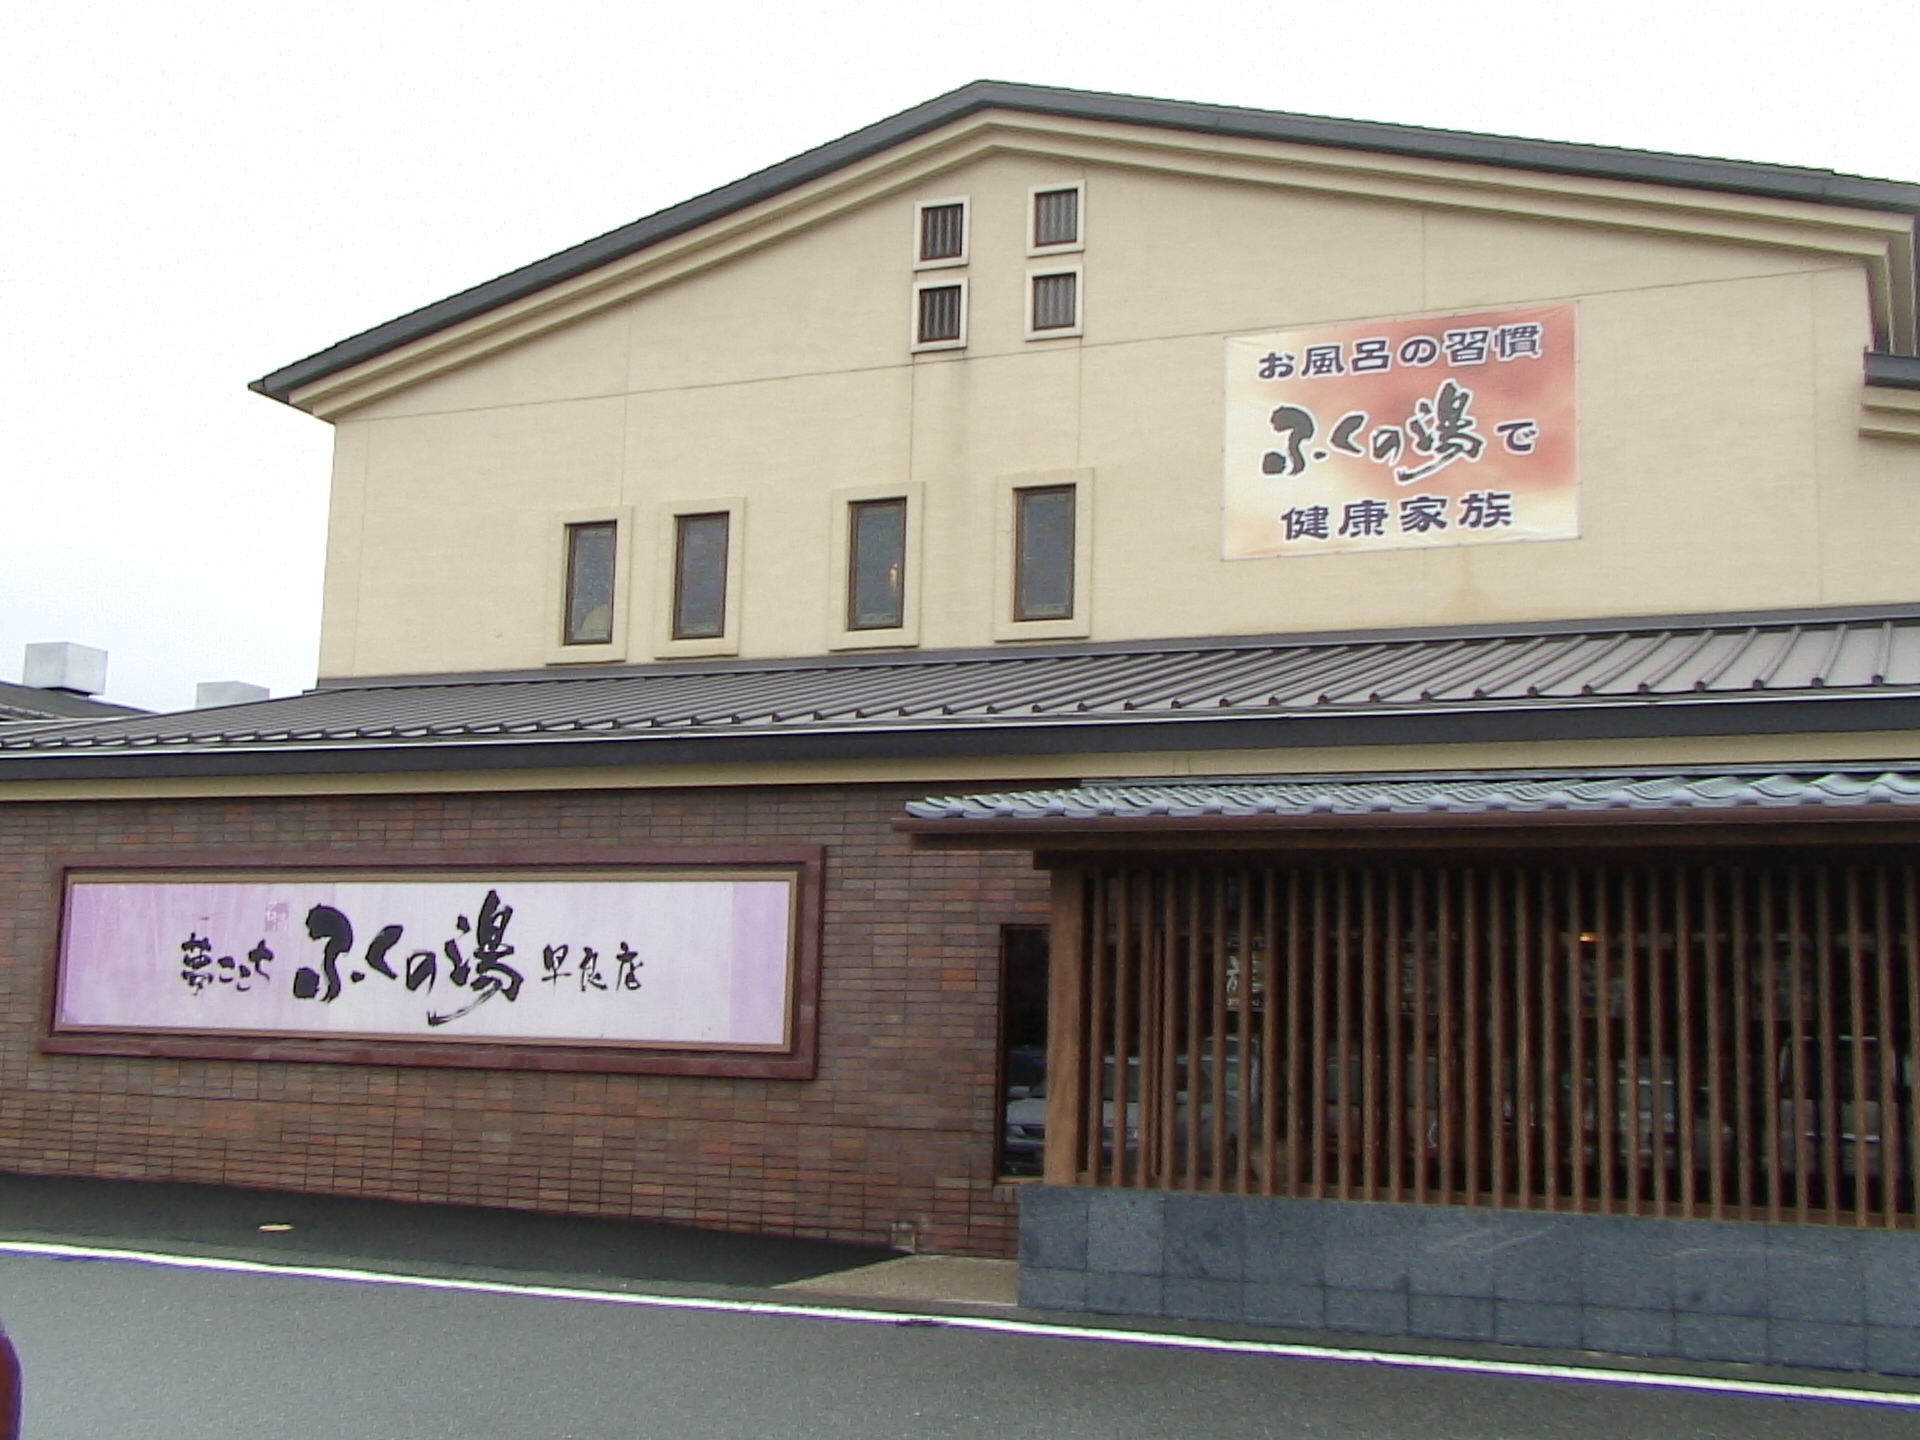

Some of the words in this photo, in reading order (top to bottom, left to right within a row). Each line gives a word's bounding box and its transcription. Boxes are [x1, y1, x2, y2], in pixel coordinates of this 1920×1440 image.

[1258, 324, 1541, 379] お風呂の習慣
[1280, 492, 1512, 541] 健康家族
[294, 889, 524, 1027] ふくの湯
[541, 941, 644, 992] 早良店
